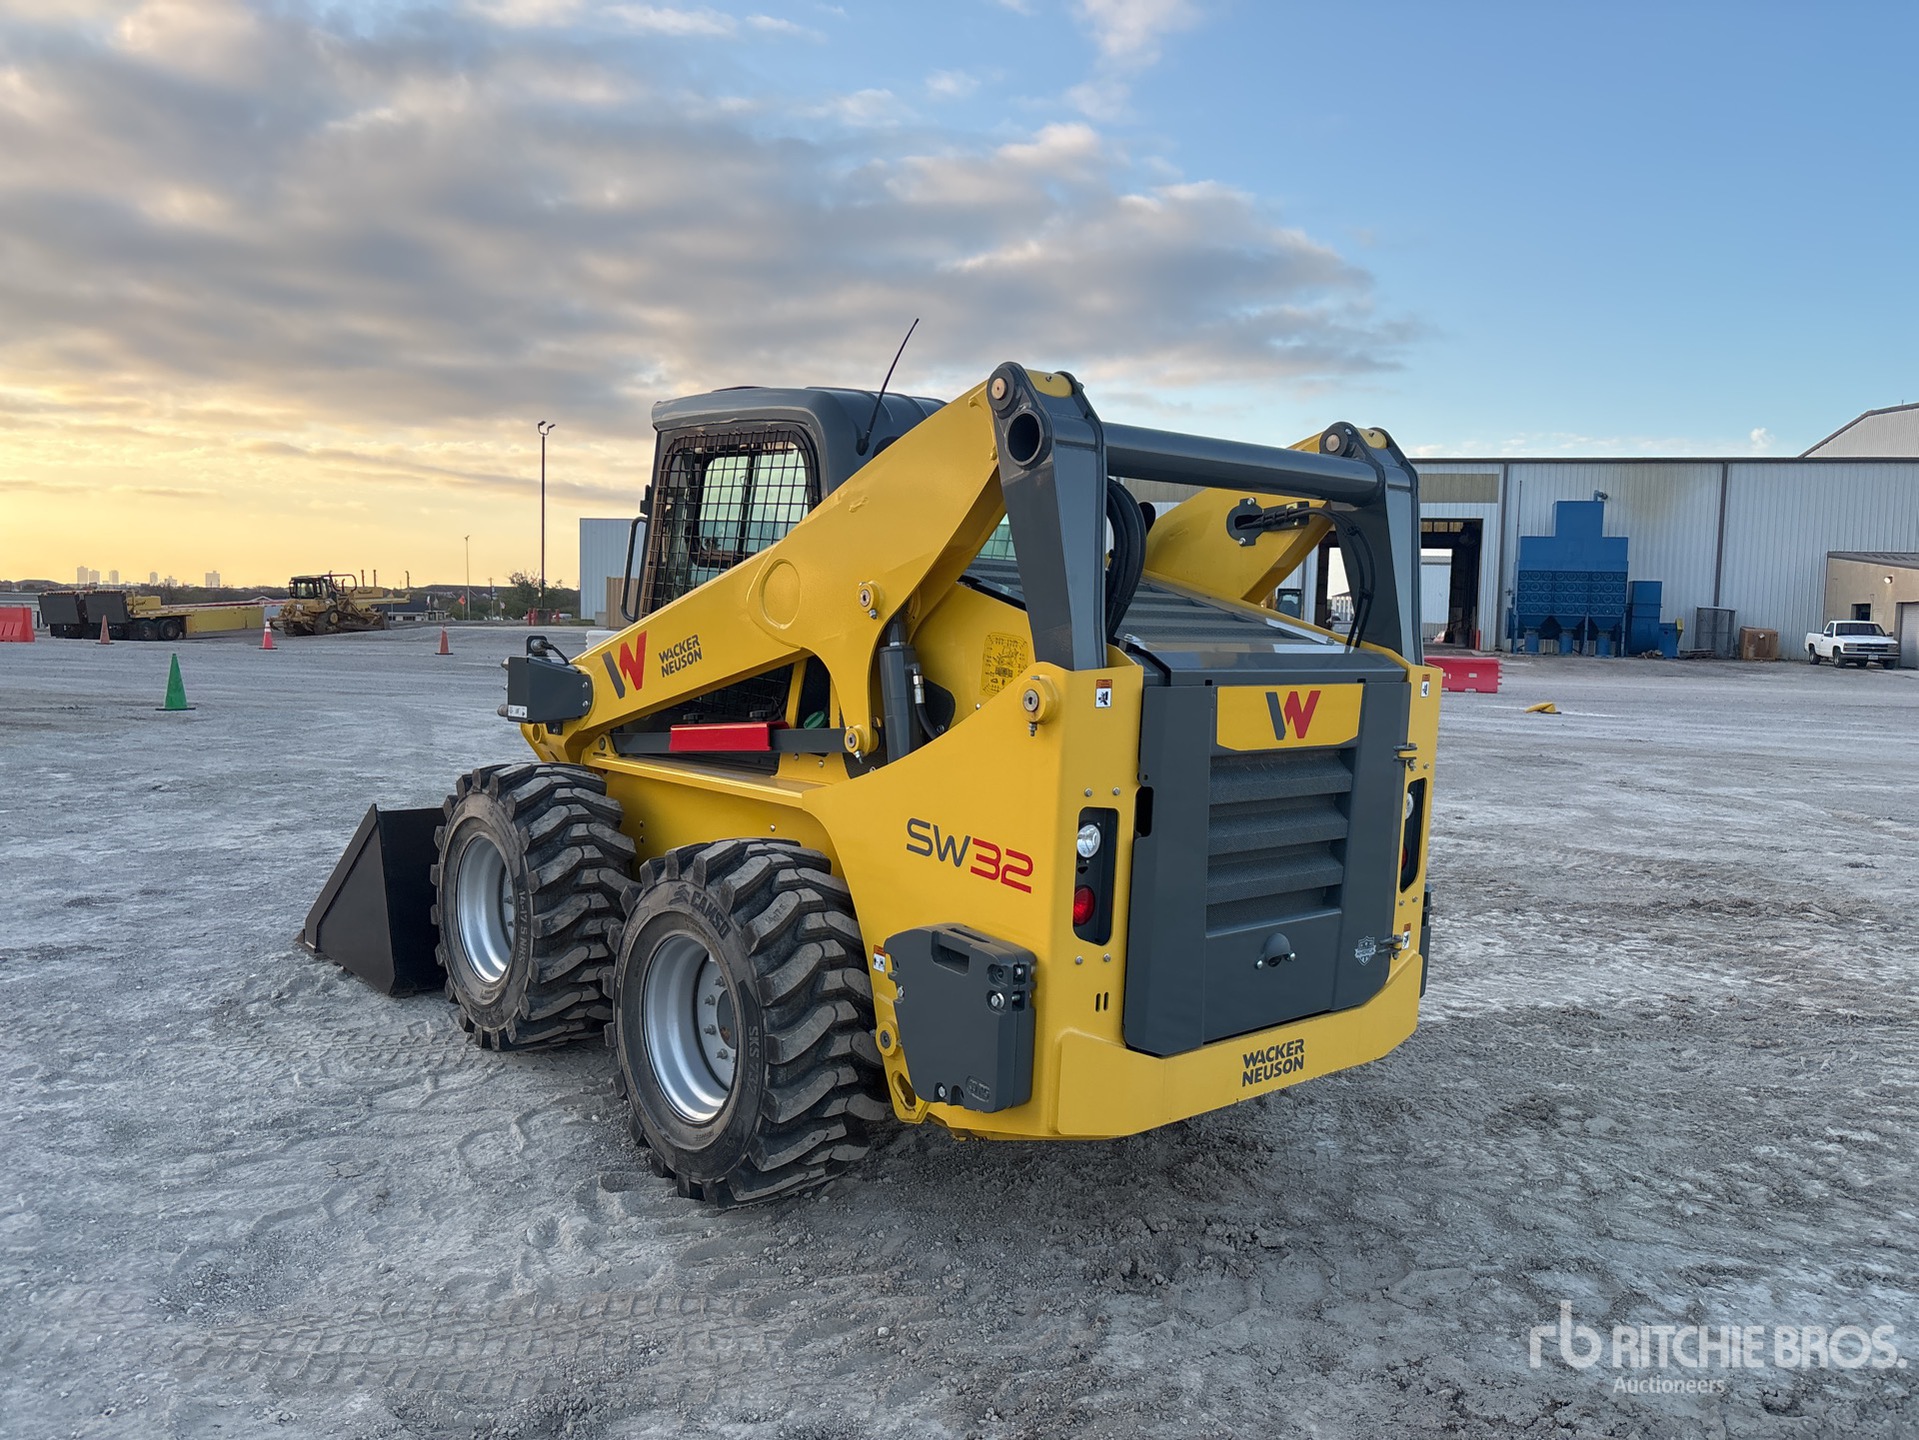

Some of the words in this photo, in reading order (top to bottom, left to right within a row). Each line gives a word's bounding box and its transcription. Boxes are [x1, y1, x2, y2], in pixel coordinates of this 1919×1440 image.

[658, 634, 700, 664] WACKER
[661, 647, 703, 678] NEUSON
[906, 817, 1034, 894] SW32
[748, 1025, 760, 1058] SKS
[1243, 1038, 1305, 1069] WACKER
[1242, 1055, 1305, 1087] NEUSON
